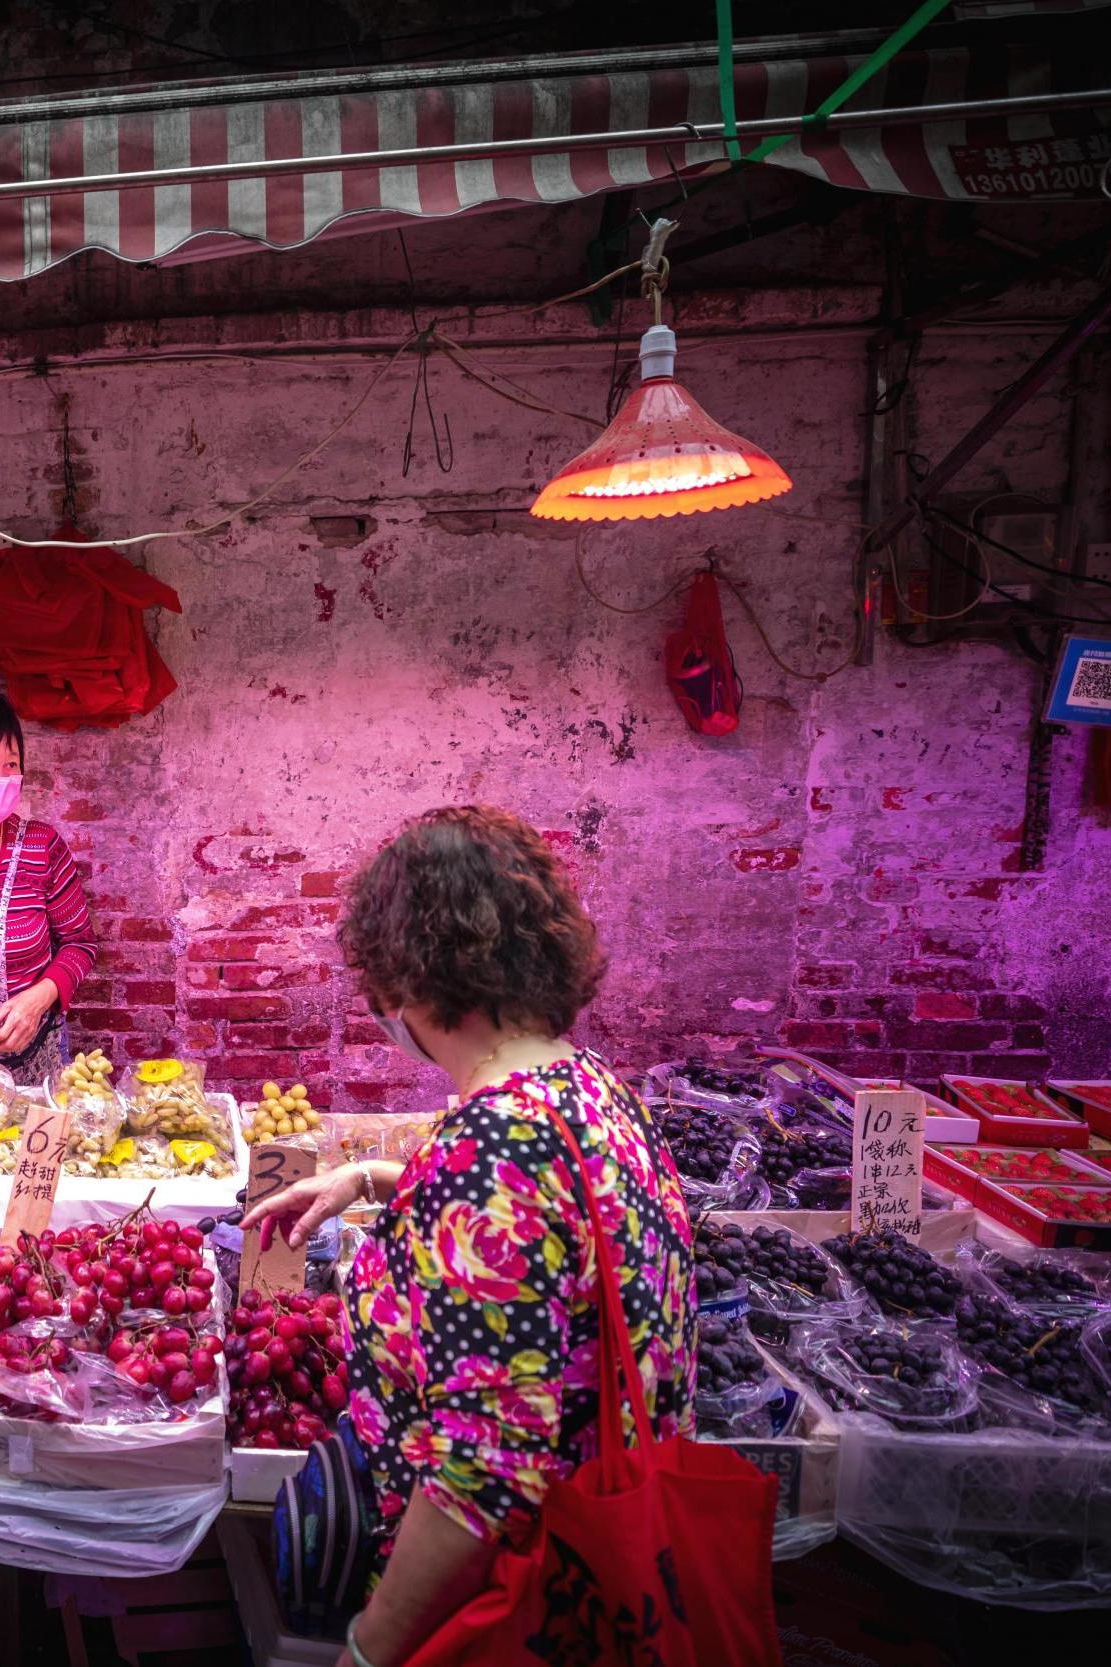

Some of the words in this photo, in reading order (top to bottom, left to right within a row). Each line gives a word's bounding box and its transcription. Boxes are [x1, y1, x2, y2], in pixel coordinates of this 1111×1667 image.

[862, 1104, 925, 1140] 10元
[26, 1116, 68, 1164] 6元
[248, 1151, 301, 1202] 3
[863, 1162, 918, 1183] 1串12元
[14, 1180, 55, 1203] 红提
[857, 1182, 893, 1200] 正宗
